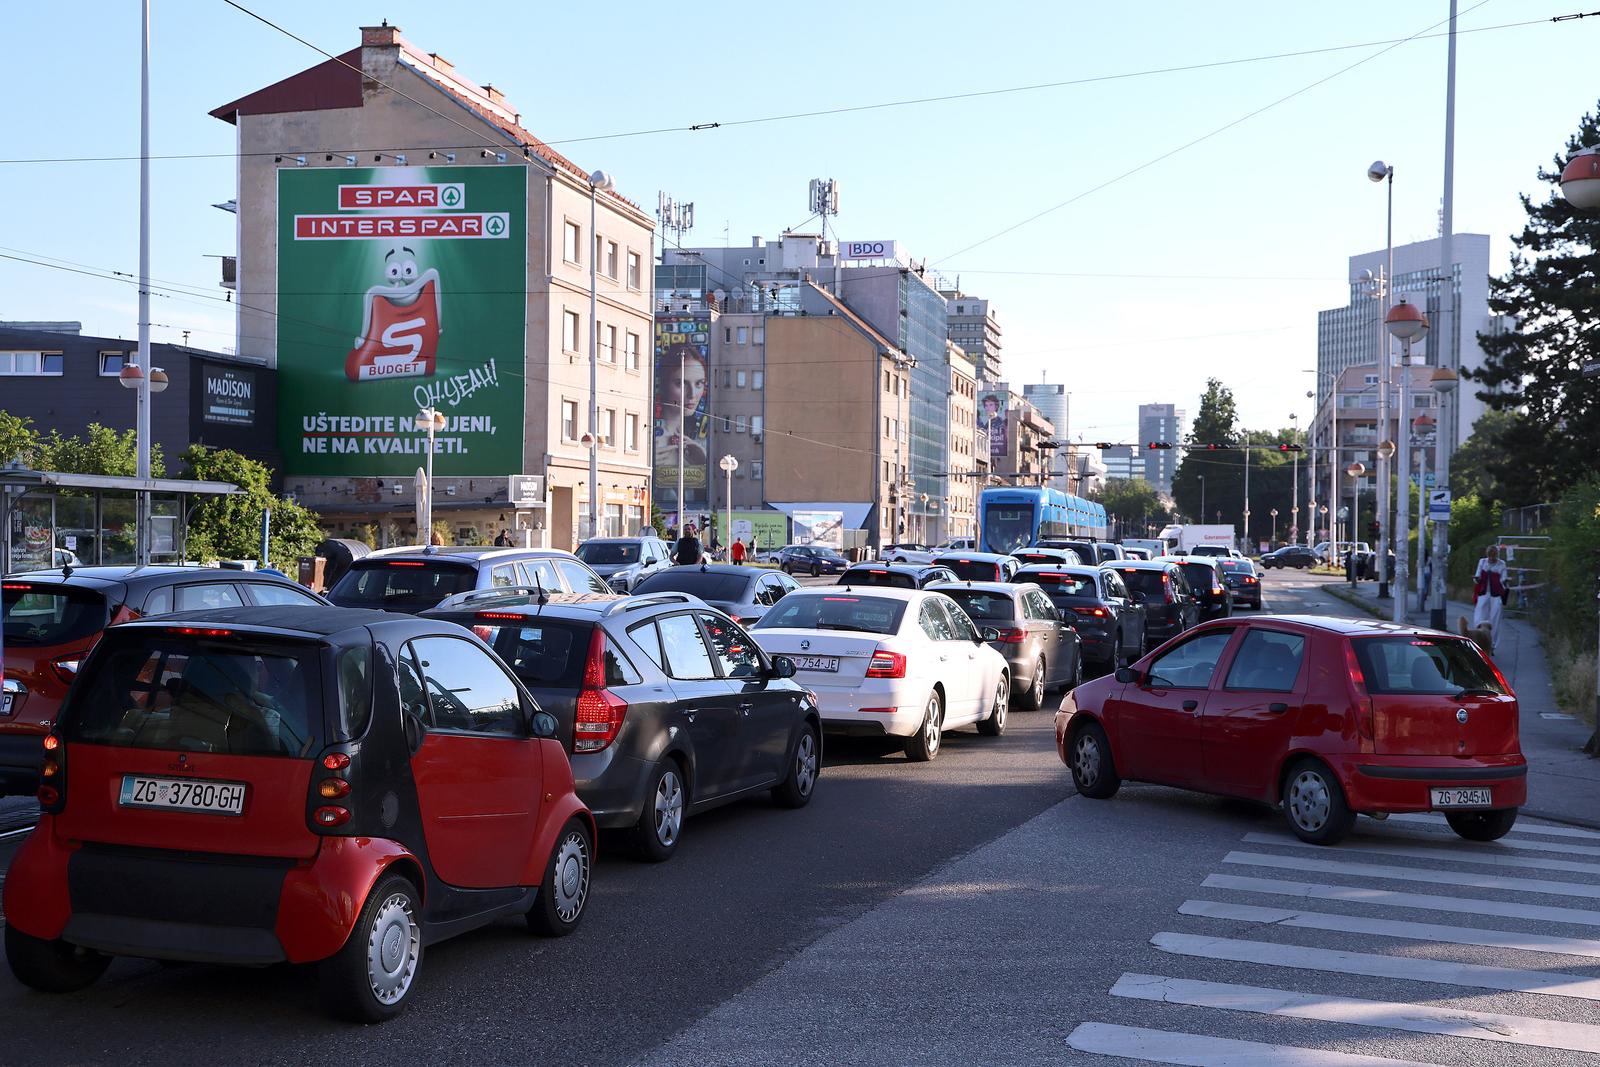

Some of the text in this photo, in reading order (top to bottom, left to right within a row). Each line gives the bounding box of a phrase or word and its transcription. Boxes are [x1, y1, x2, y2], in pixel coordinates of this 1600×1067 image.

[355, 190, 435, 204] SPAR
[311, 219, 479, 234] INTERSPAR
[853, 243, 884, 254] BDO
[369, 363, 419, 376] BUDGET
[208, 377, 251, 399] MADISON
[302, 411, 395, 432] UŠTEDITE
[302, 438, 468, 454] NE NA KVALITETI.
[134, 781, 157, 802] ZG
[1438, 791, 1451, 804] ZG
